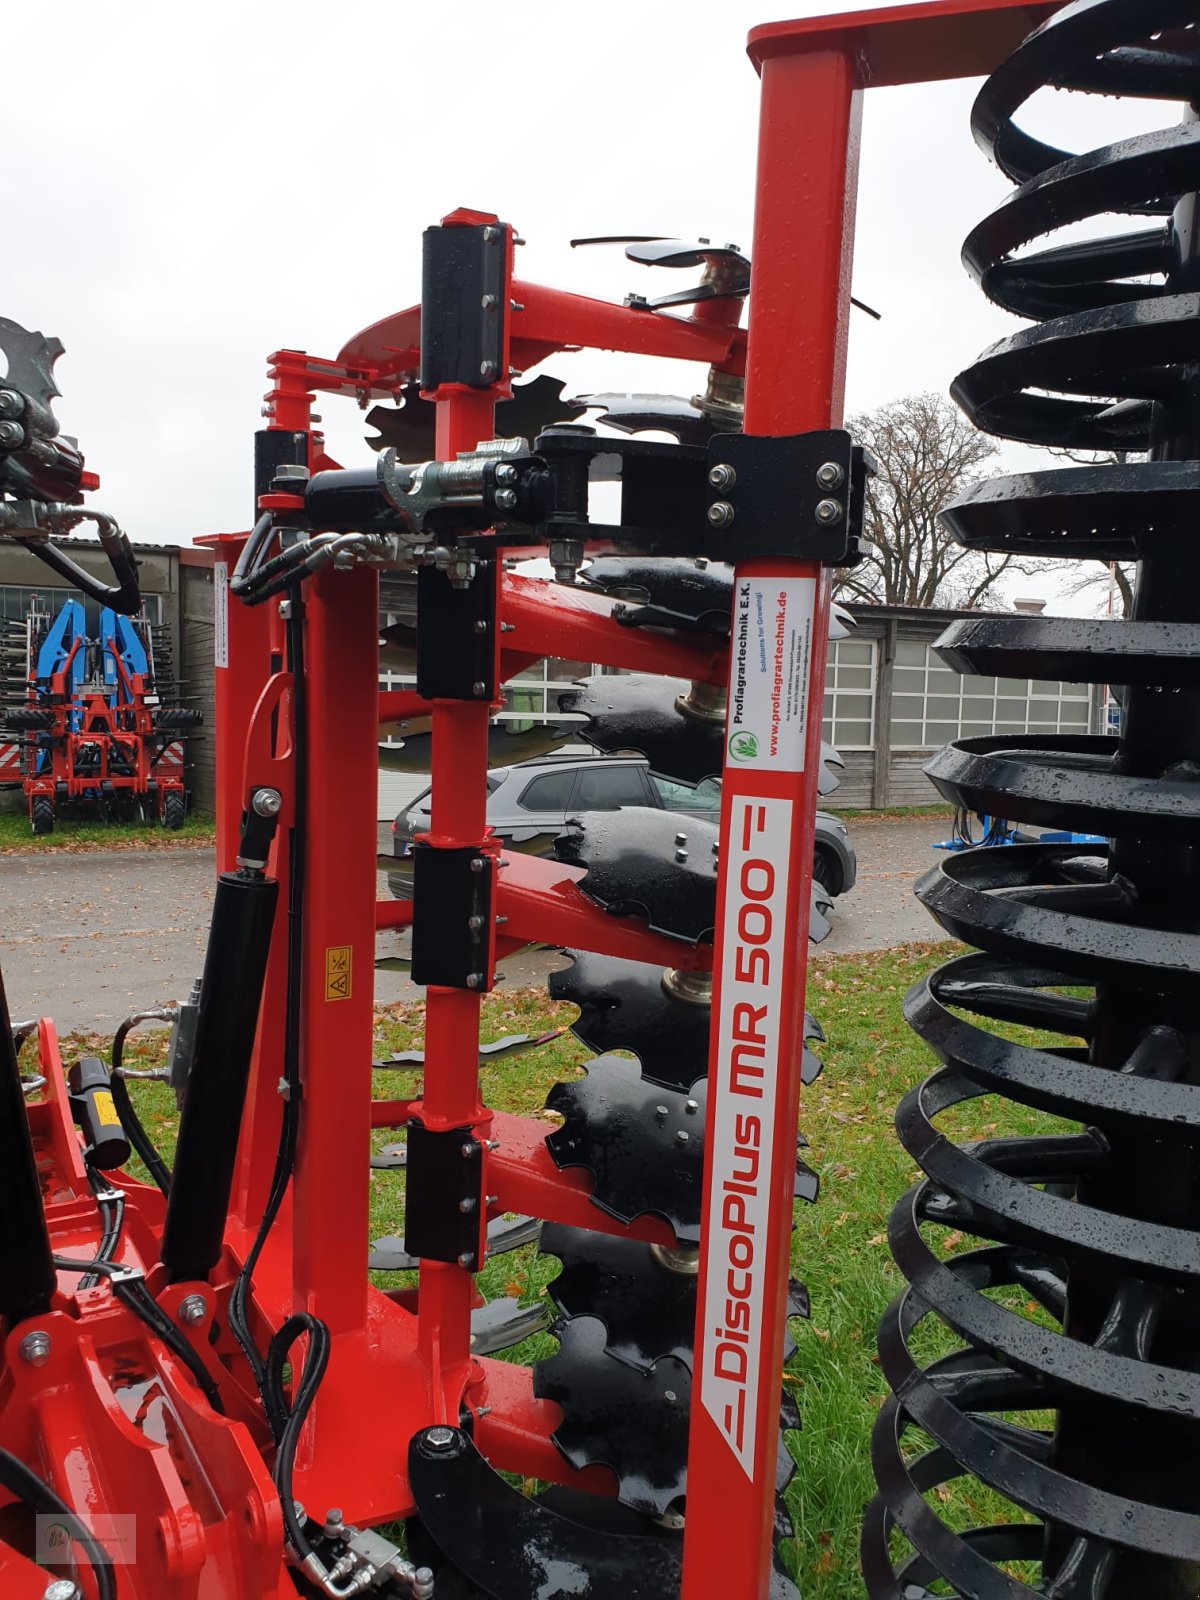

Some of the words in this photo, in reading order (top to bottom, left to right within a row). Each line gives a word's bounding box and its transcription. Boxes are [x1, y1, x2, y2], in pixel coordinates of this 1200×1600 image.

[740, 582, 751, 609] E.K.
[756, 592, 764, 624] Growing!
[733, 613, 749, 724] Profiagrartechnik
[769, 591, 787, 757] www.profiagrartechnik.de
[734, 858, 776, 986] 500
[729, 1001, 768, 1099] MR
[714, 1113, 761, 1385] DiscoPlus
